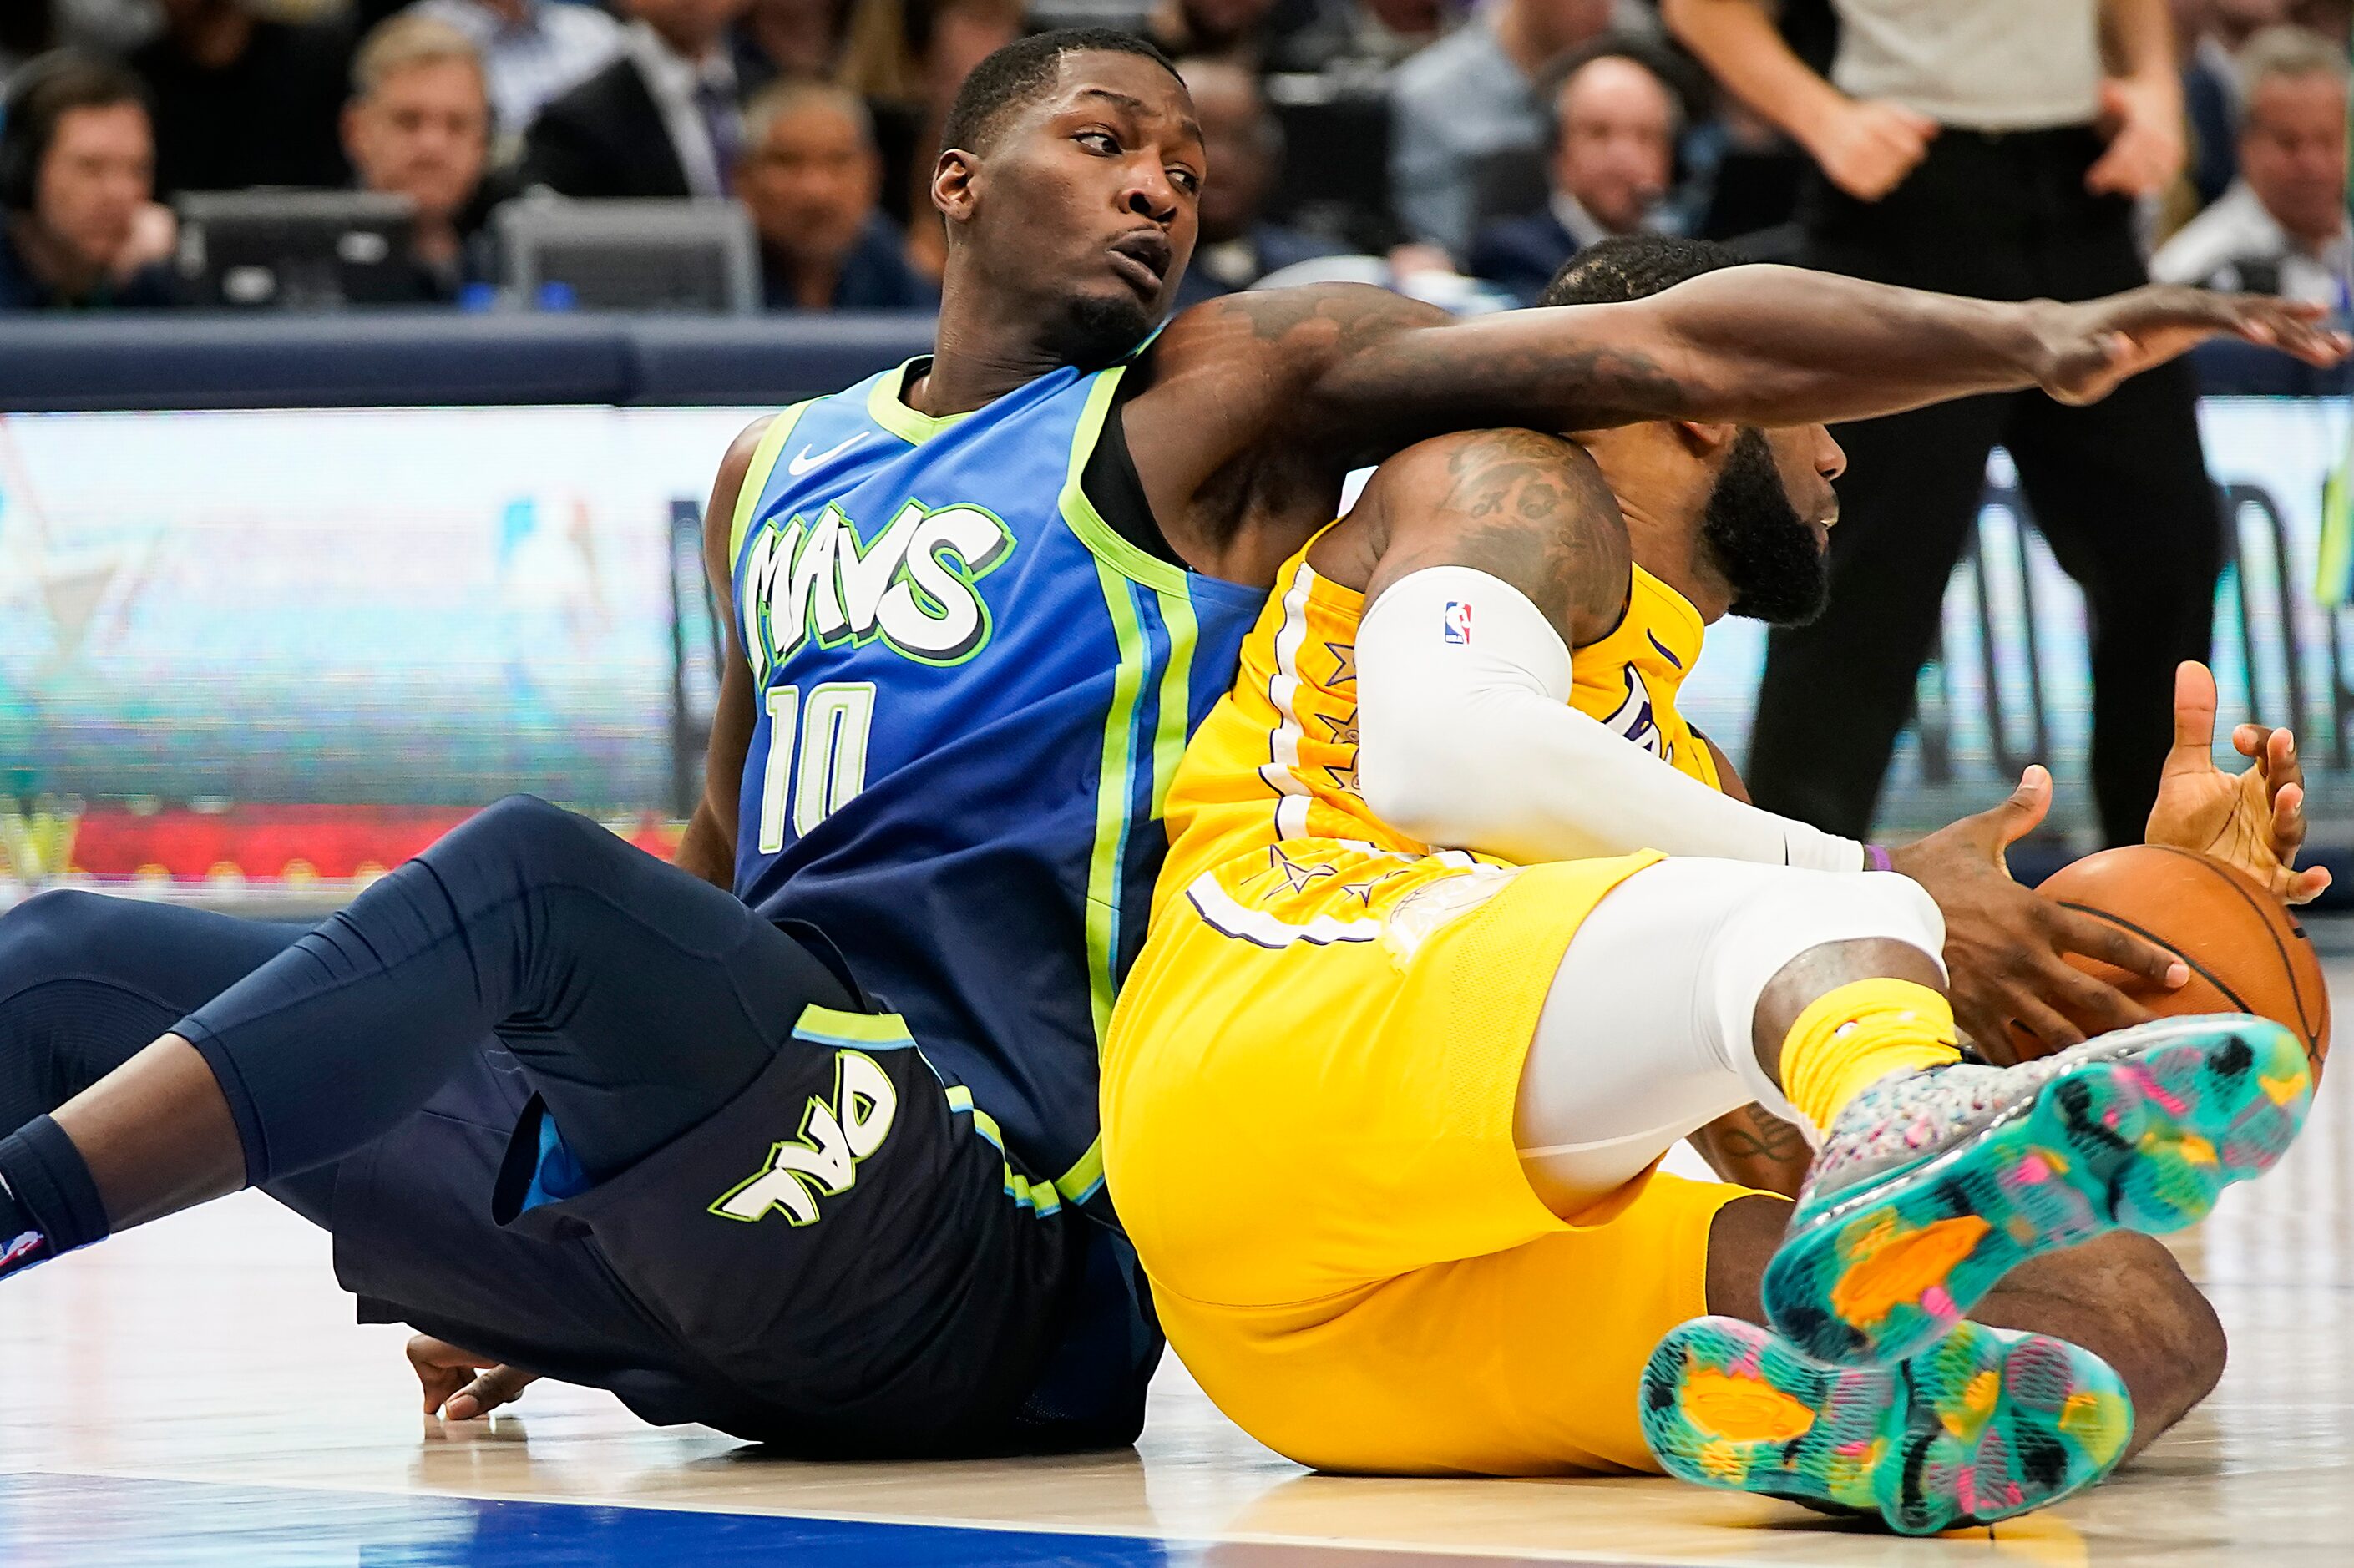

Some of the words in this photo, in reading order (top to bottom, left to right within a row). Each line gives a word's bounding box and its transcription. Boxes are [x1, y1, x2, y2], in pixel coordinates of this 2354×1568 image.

[742, 496, 1018, 694] MAVS
[758, 681, 877, 855] 10
[707, 1049, 897, 1227] DAL
